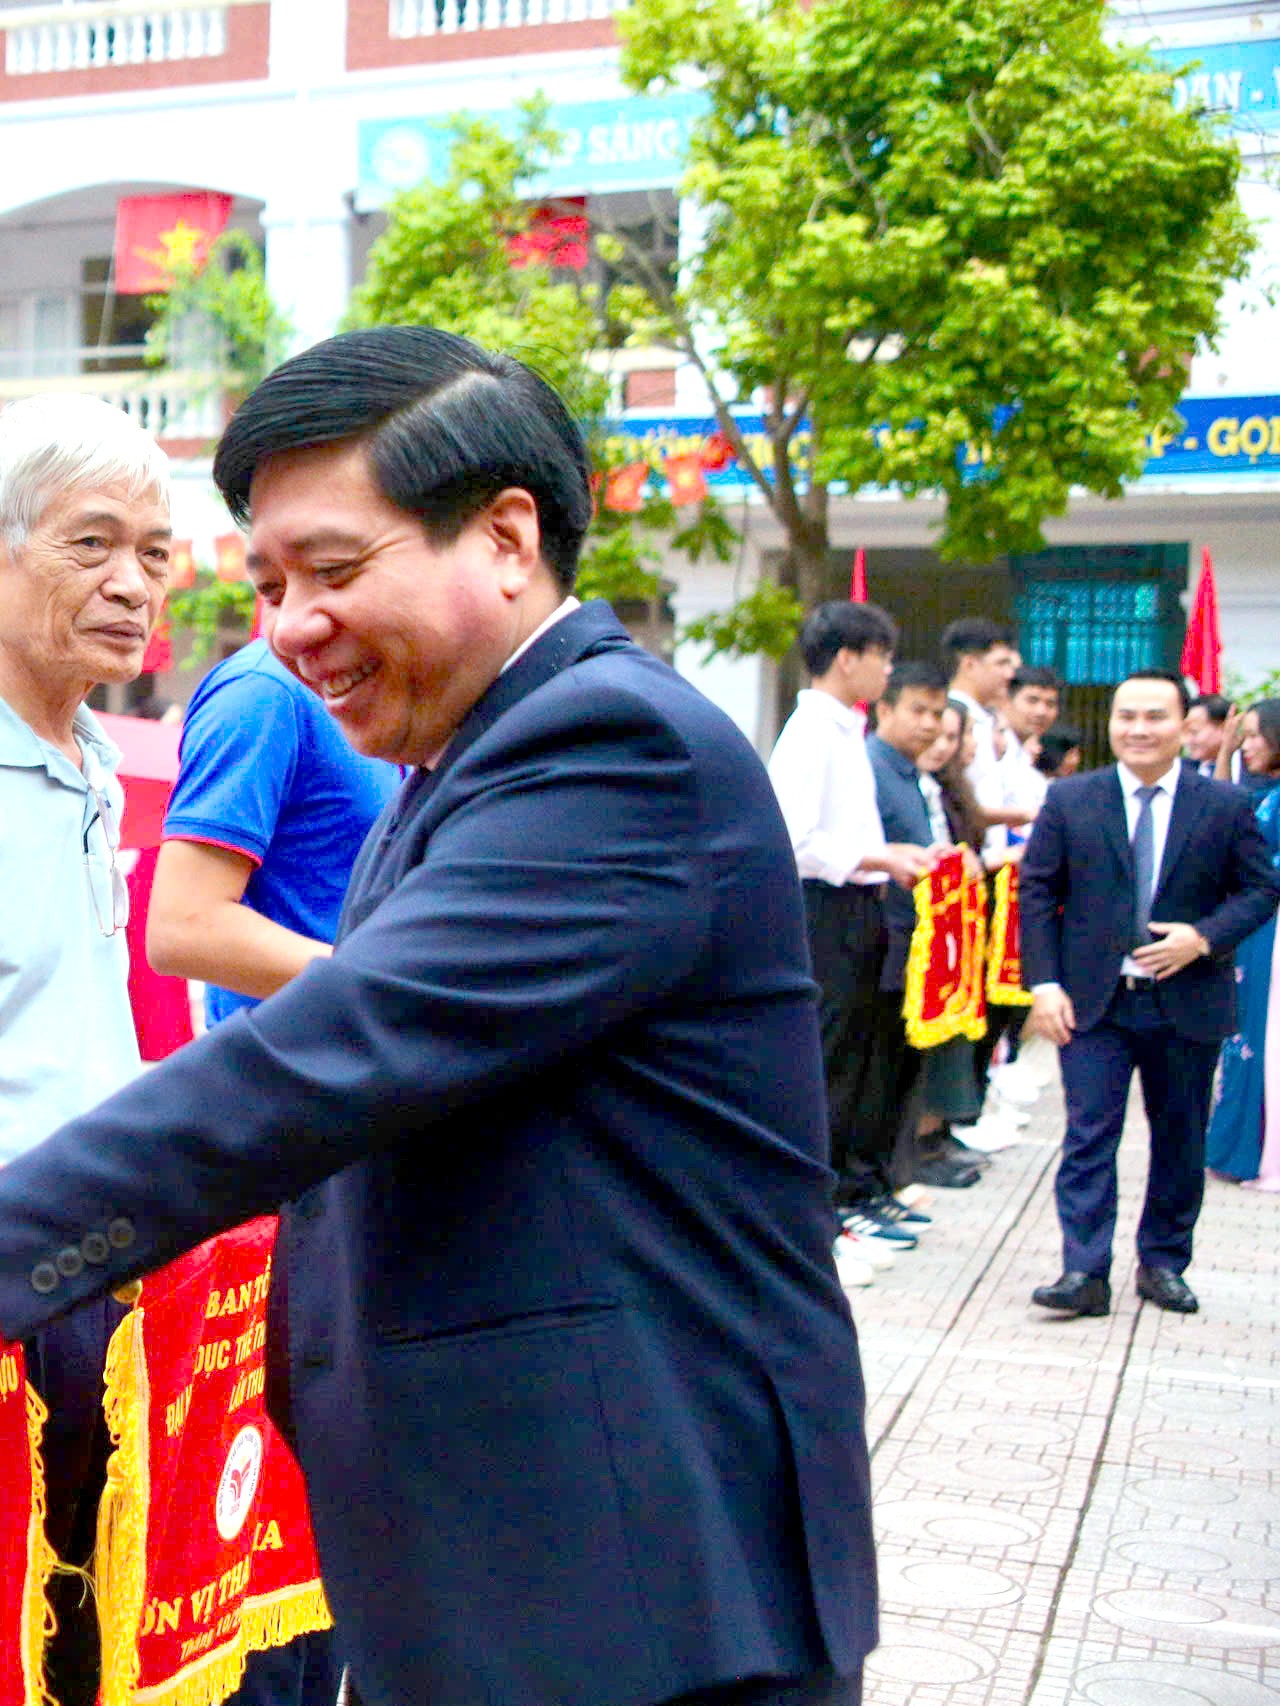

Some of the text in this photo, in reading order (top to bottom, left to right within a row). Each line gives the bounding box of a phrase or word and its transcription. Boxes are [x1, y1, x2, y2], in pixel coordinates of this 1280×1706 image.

[205, 1280, 252, 1319] BAN
[140, 1597, 183, 1636] ƠN
[191, 1582, 217, 1623] VỊ
[252, 1520, 283, 1551] IA
